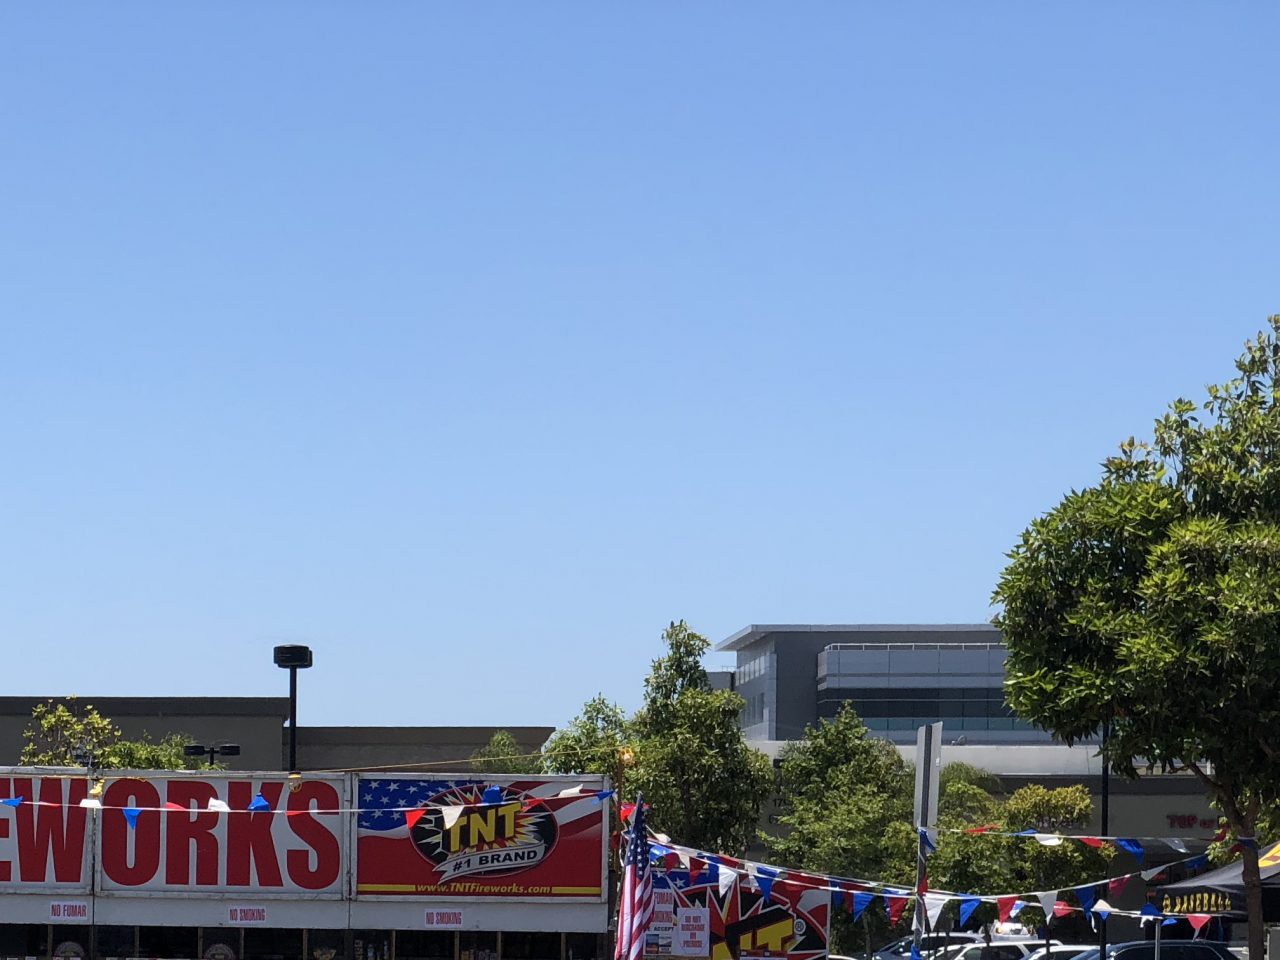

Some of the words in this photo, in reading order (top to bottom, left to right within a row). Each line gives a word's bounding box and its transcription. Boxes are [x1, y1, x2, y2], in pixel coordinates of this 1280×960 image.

[448, 802, 521, 852] TNT
[453, 859, 470, 872] #1
[478, 850, 537, 866] BRAND
[416, 883, 551, 894] www.TNTFireworks.com
[51, 904, 60, 916] NO
[63, 904, 86, 917] FUMAR
[230, 909, 237, 921] NO
[240, 909, 265, 921] SMOKING
[426, 912, 434, 924] NO
[436, 912, 461, 924] SMOKING
